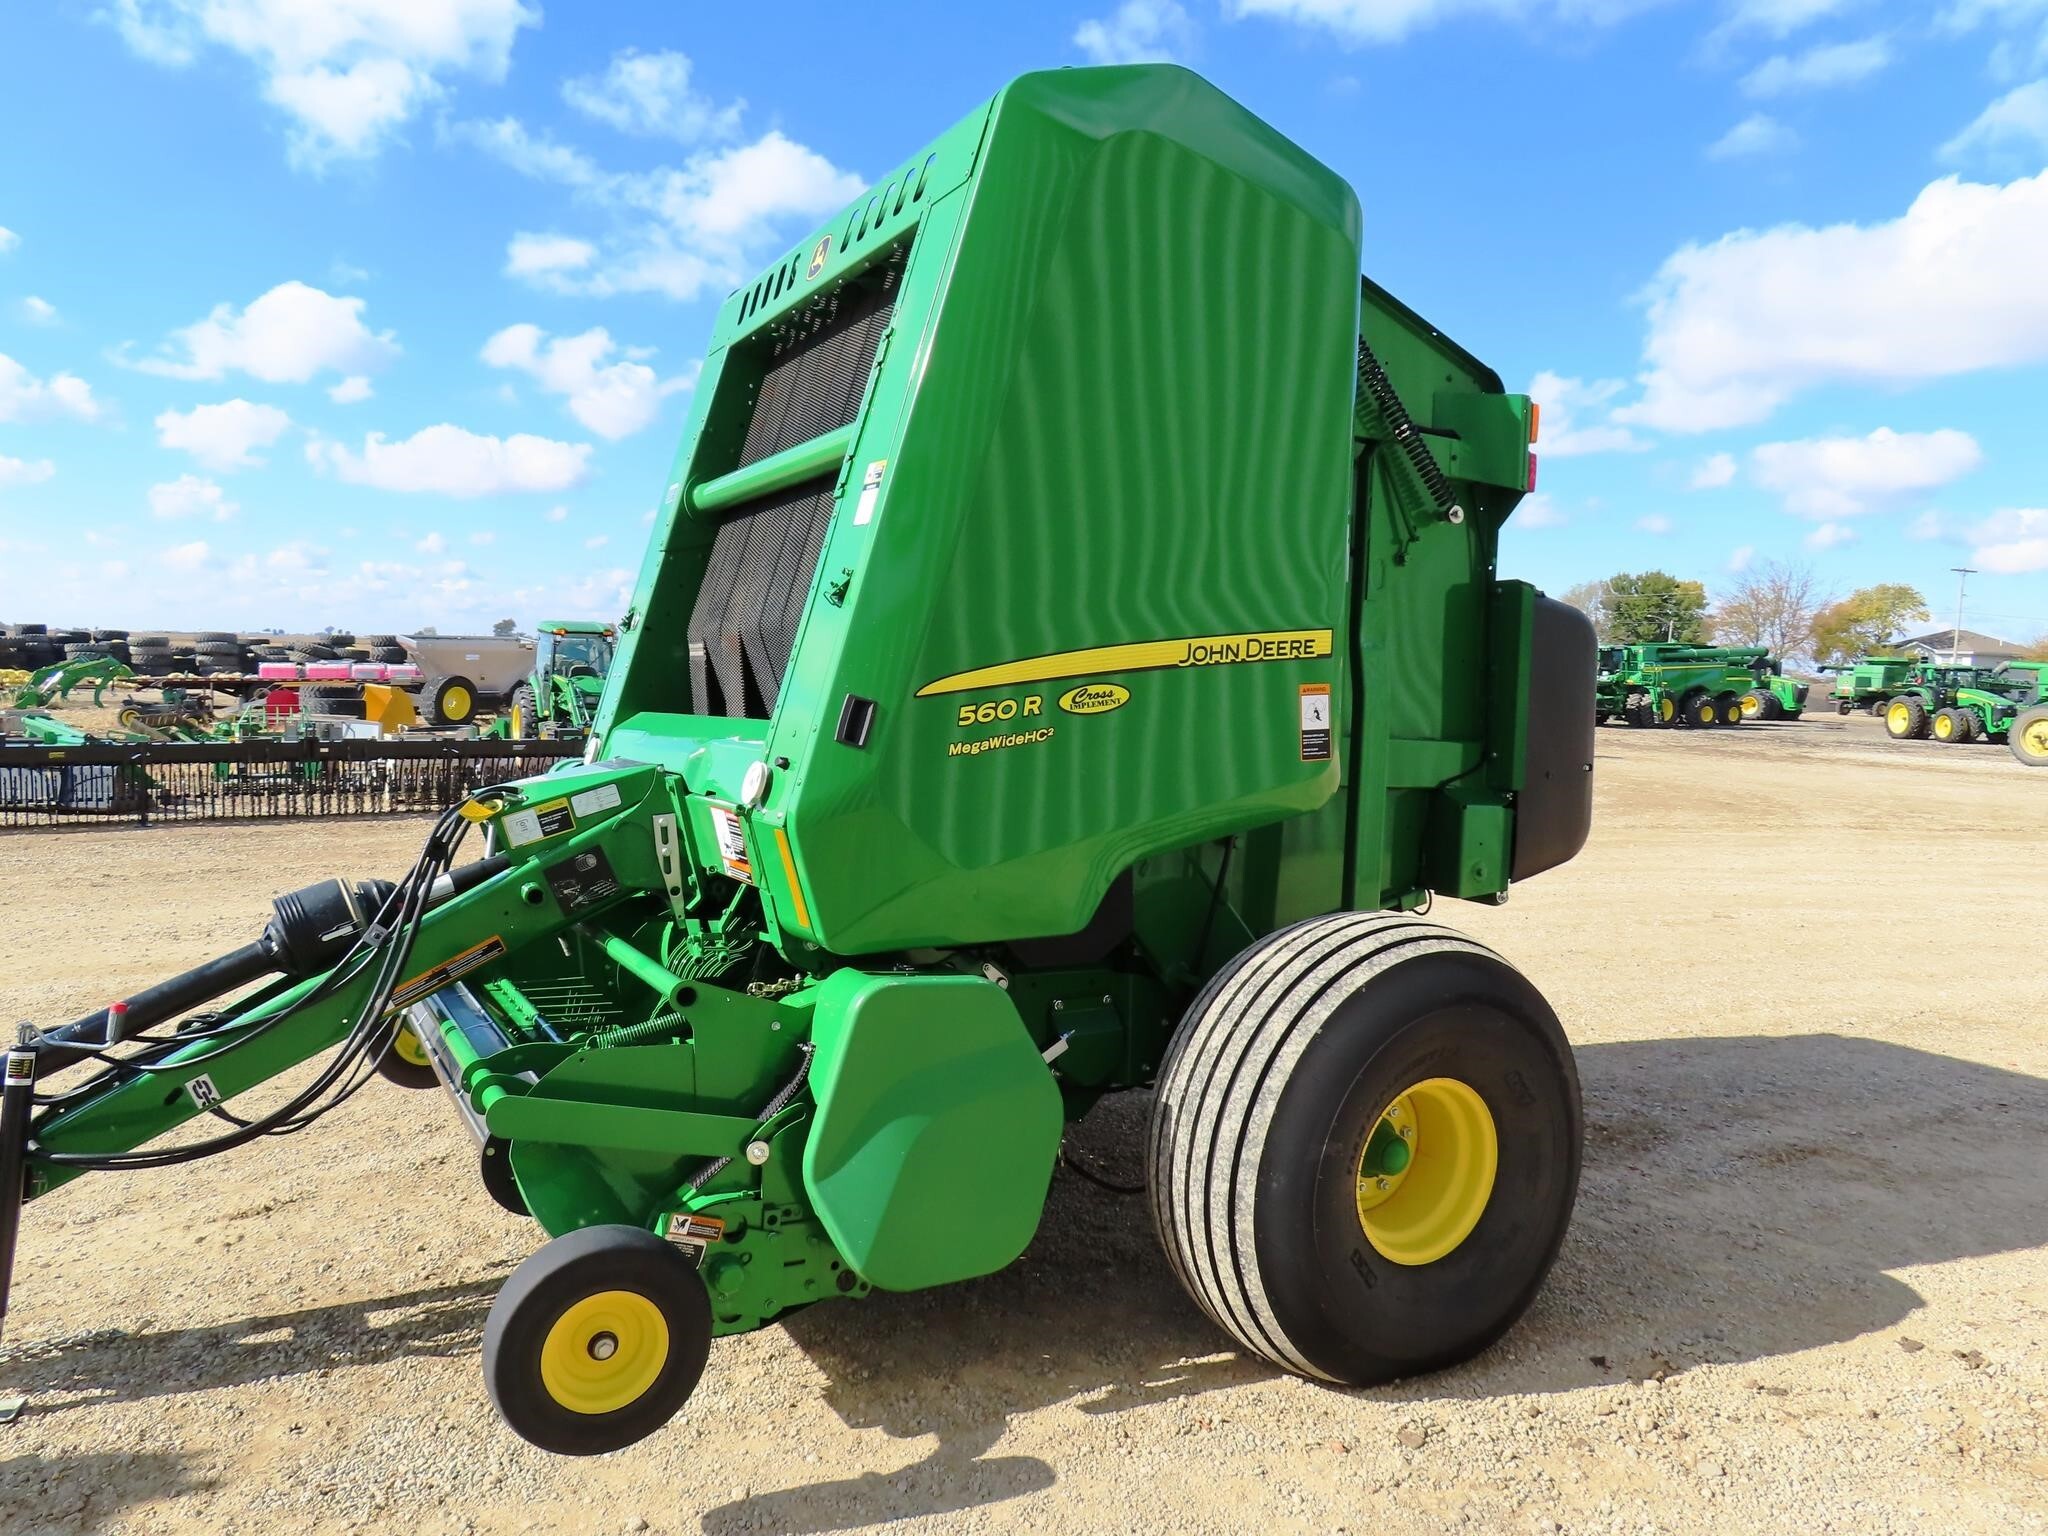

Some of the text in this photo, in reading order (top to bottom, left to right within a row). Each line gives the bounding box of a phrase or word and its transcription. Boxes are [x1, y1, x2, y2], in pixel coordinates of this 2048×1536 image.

[1179, 639, 1316, 664] JOHN DEERE
[1070, 698, 1121, 710] IMPLEMENT
[1071, 688, 1115, 704] Cross
[958, 695, 1042, 727] 560 R
